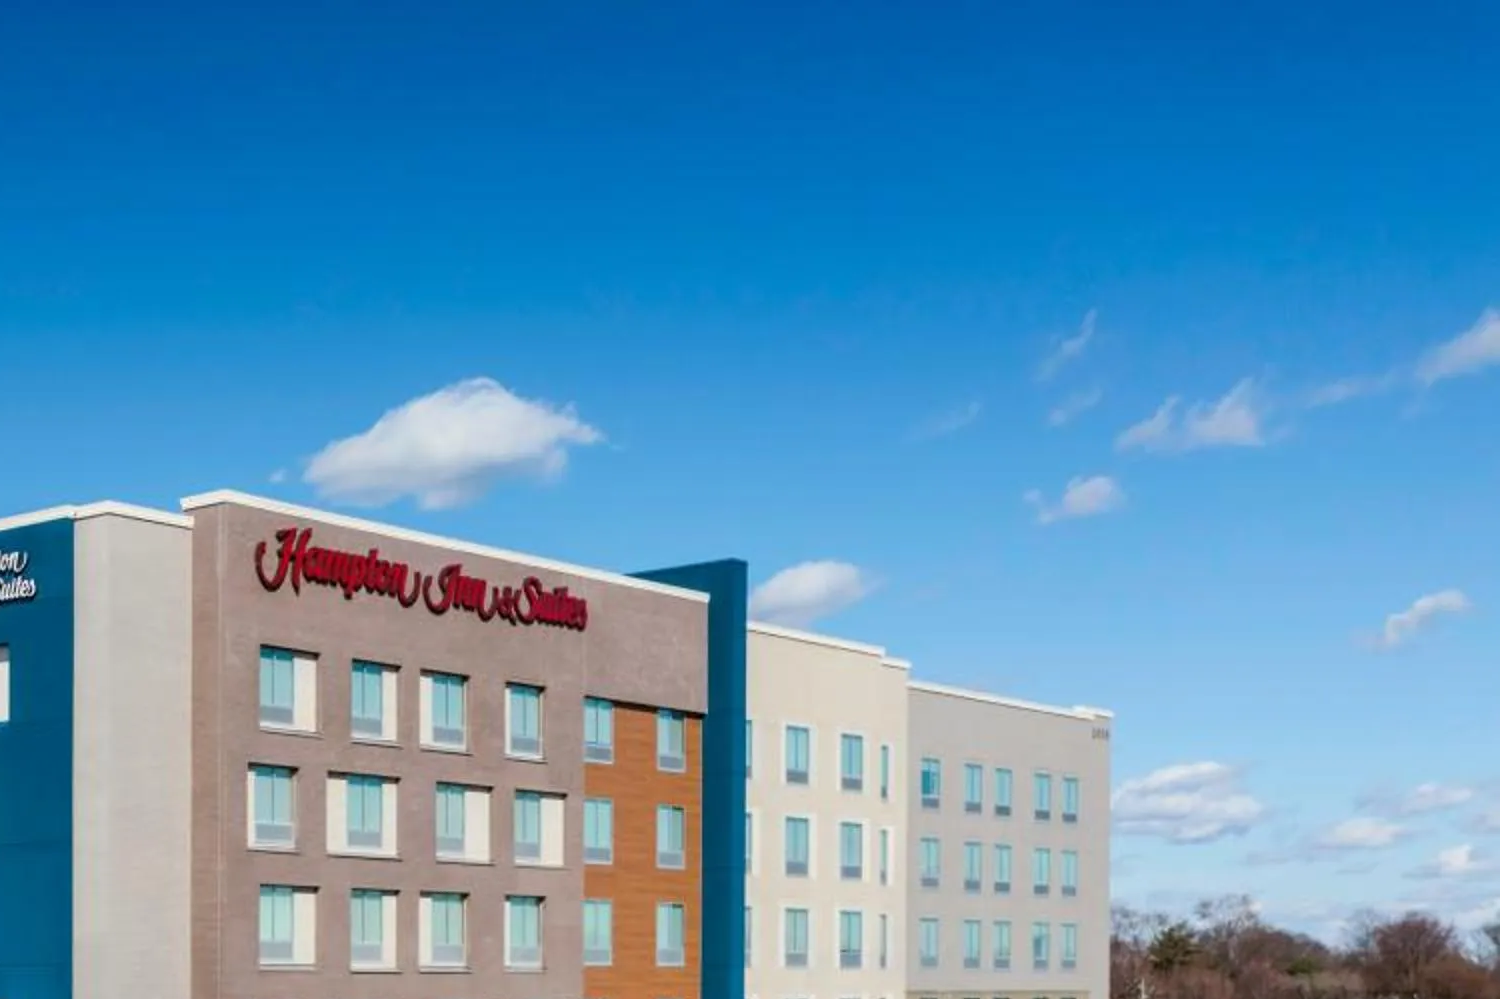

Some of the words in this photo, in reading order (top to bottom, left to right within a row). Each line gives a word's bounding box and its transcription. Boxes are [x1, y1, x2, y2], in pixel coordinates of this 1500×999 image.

[256, 528, 420, 607] Hampton
[424, 564, 499, 621] Inn
[514, 576, 588, 632] Suites
